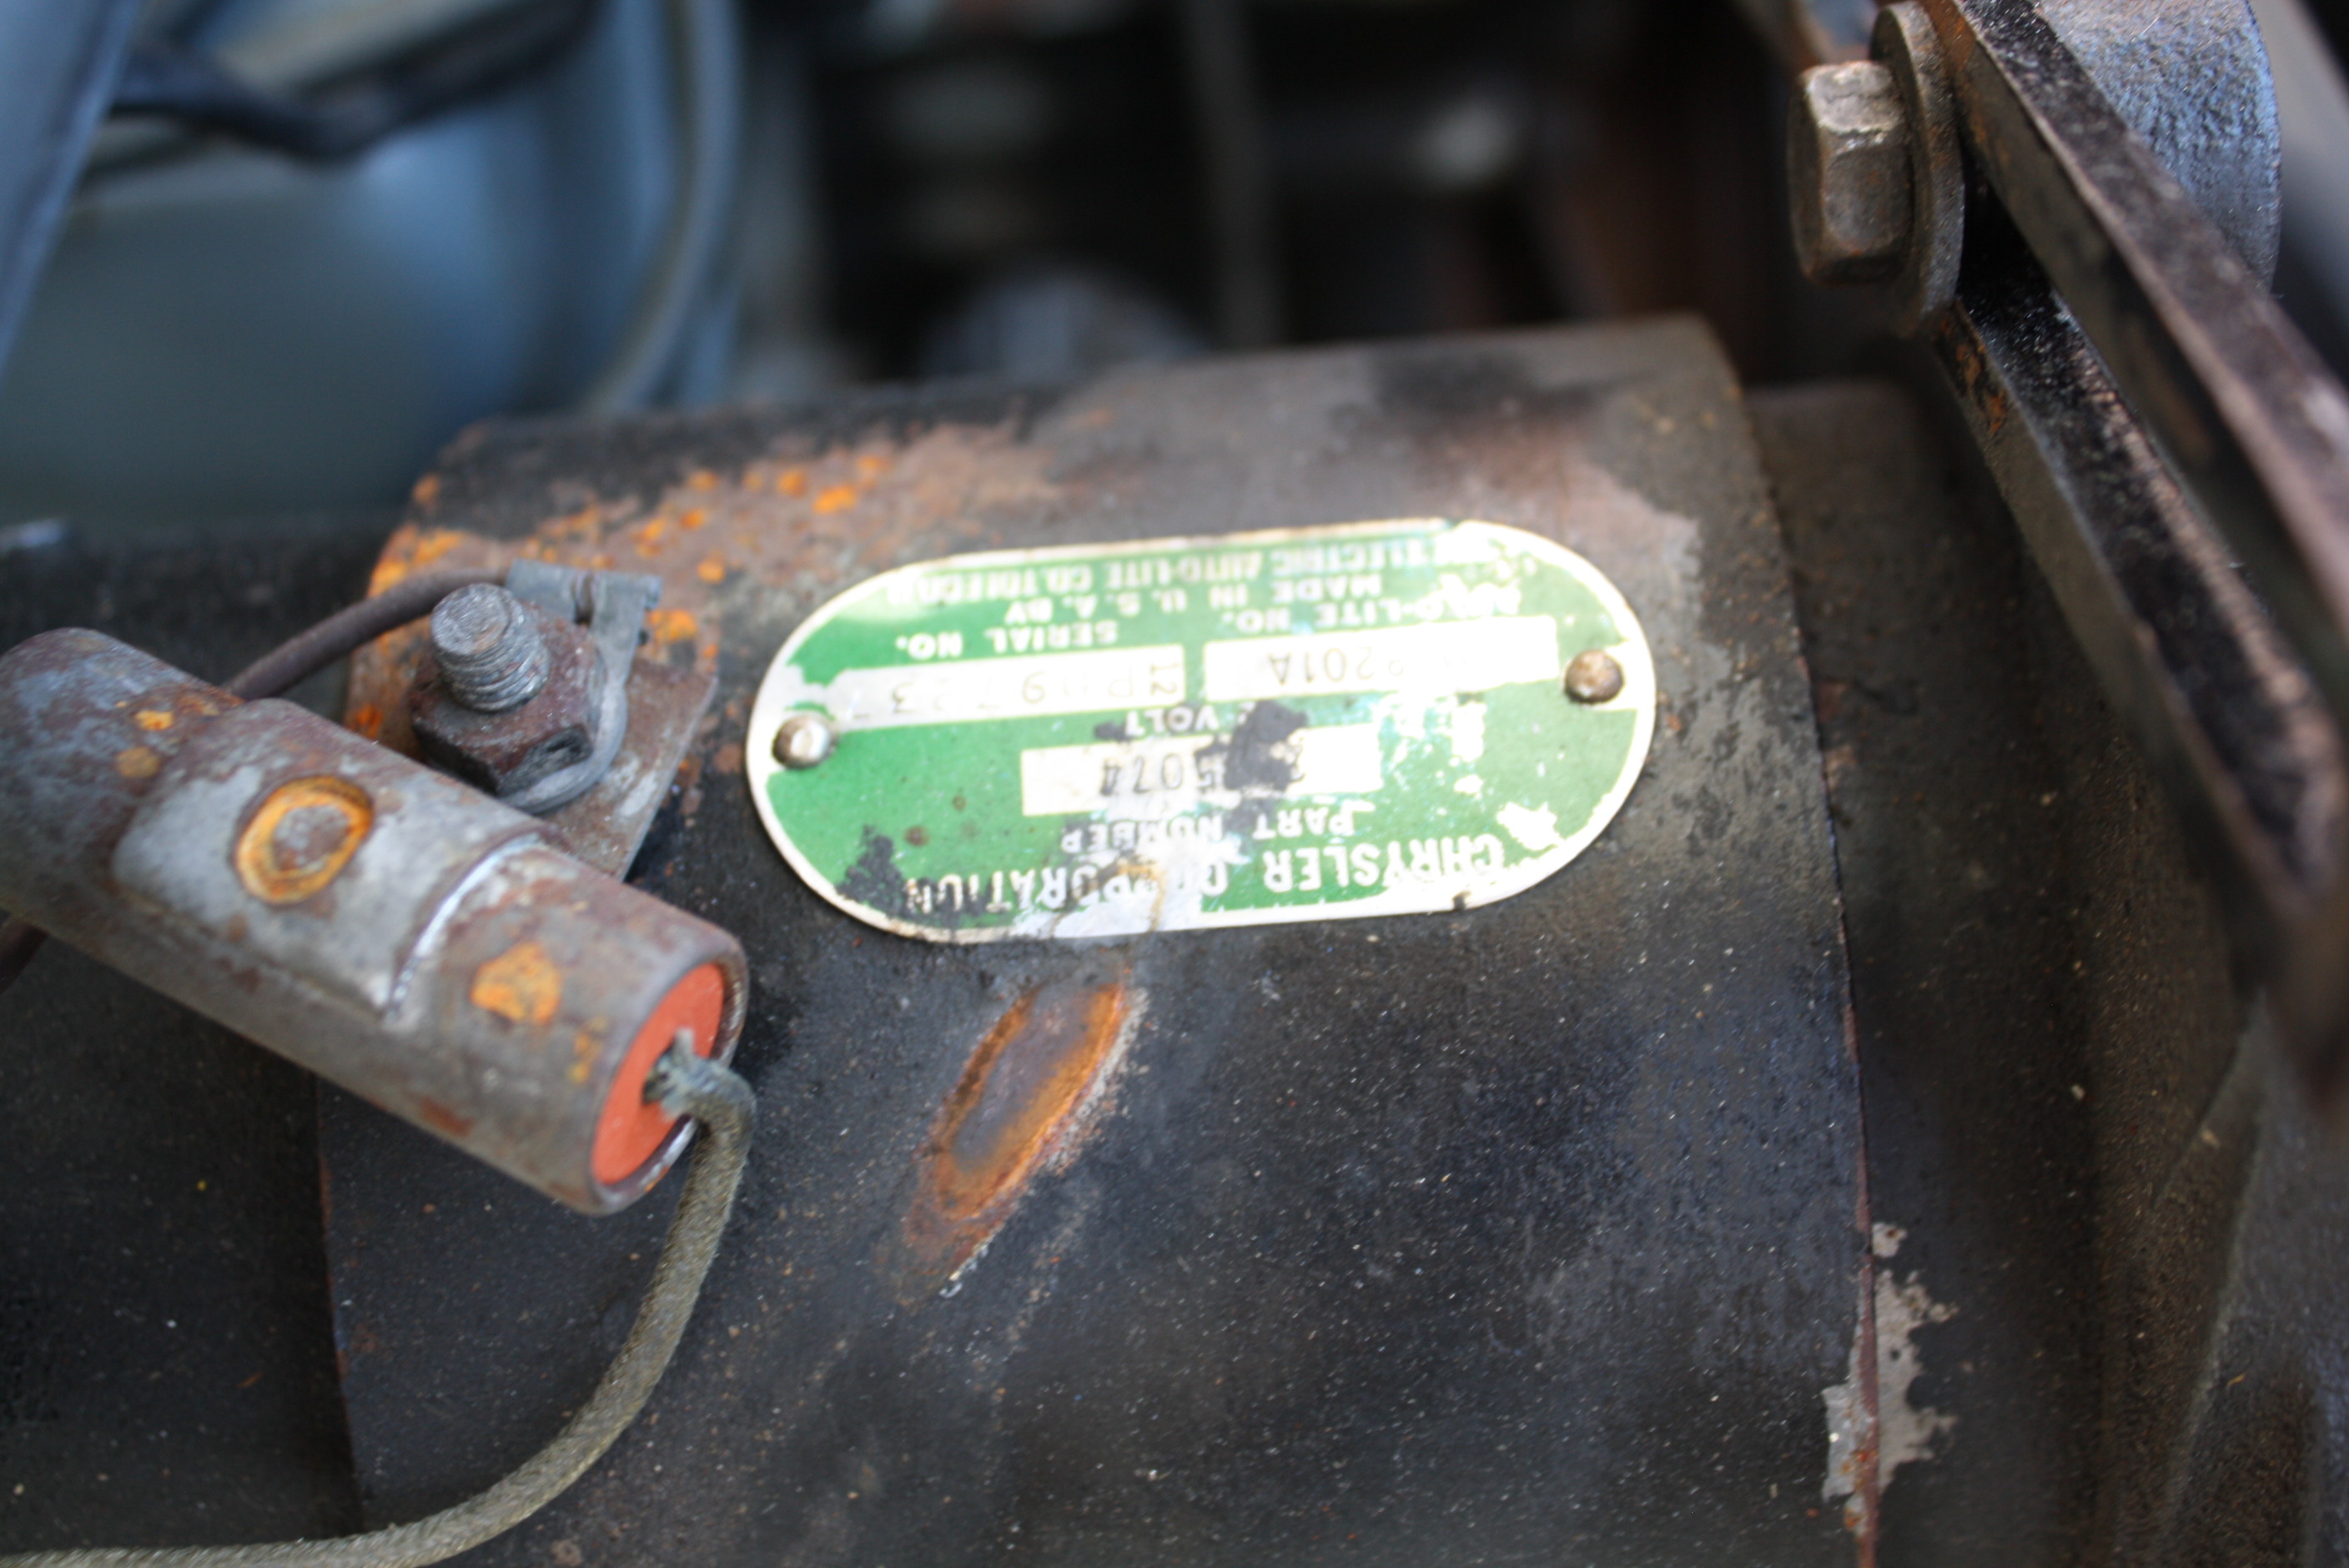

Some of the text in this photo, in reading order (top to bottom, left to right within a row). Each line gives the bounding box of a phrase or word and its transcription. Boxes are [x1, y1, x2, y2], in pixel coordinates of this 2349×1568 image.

[1105, 550, 1263, 589] AUTO-LITE
[1209, 583, 1248, 610] IN
[1271, 573, 1381, 604] MADE
[1004, 597, 1053, 625] BY
[1221, 606, 1291, 636] NO.
[895, 620, 1119, 661] SERIAL NO.
[1126, 705, 1220, 737] VOLT
[1061, 805, 1355, 855] PART NUMBER
[905, 833, 1505, 916] CHRYSLER CRPORATION
